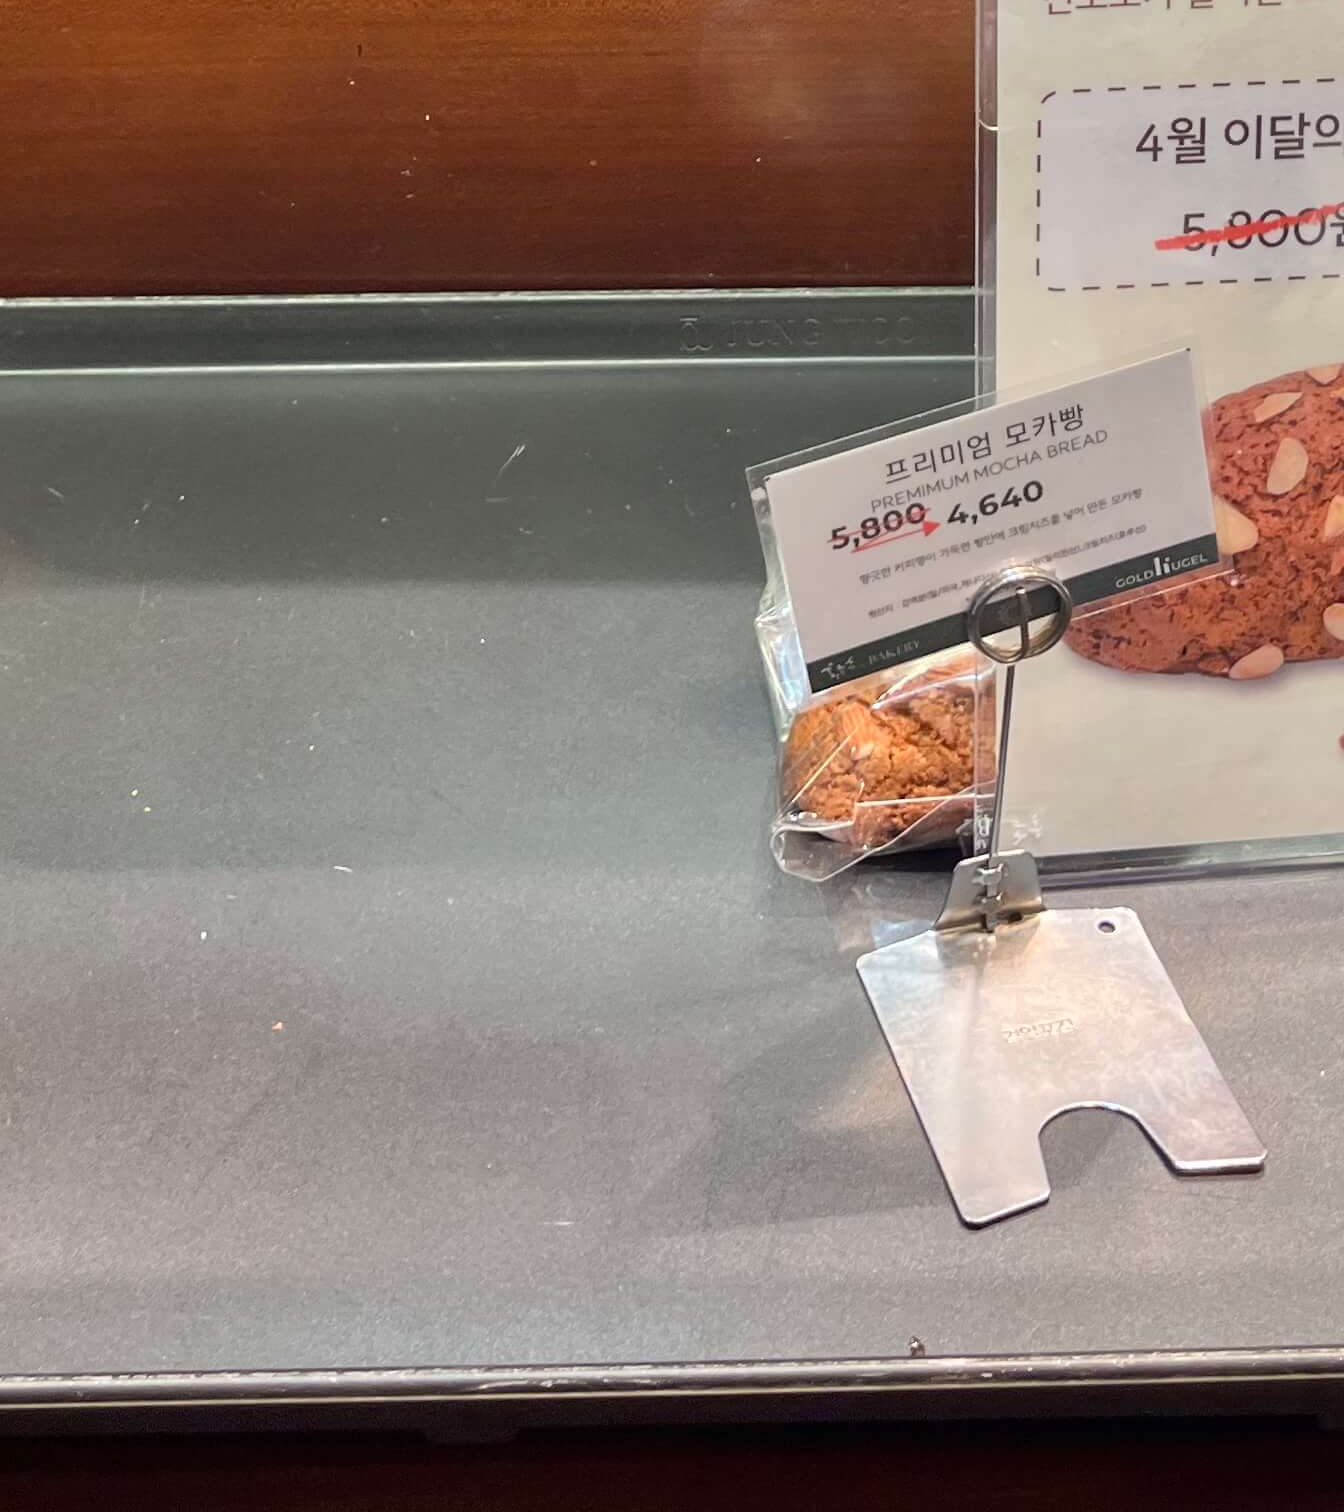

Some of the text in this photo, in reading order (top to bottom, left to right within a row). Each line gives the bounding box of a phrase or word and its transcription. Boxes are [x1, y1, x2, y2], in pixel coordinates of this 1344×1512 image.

[1135, 116, 1208, 164] 4월
[870, 428, 1109, 513] PREMIMUM MOCHA BREAD
[884, 404, 1086, 486] 프리미엄 모카빵
[830, 479, 1045, 551] 5,800 4,640
